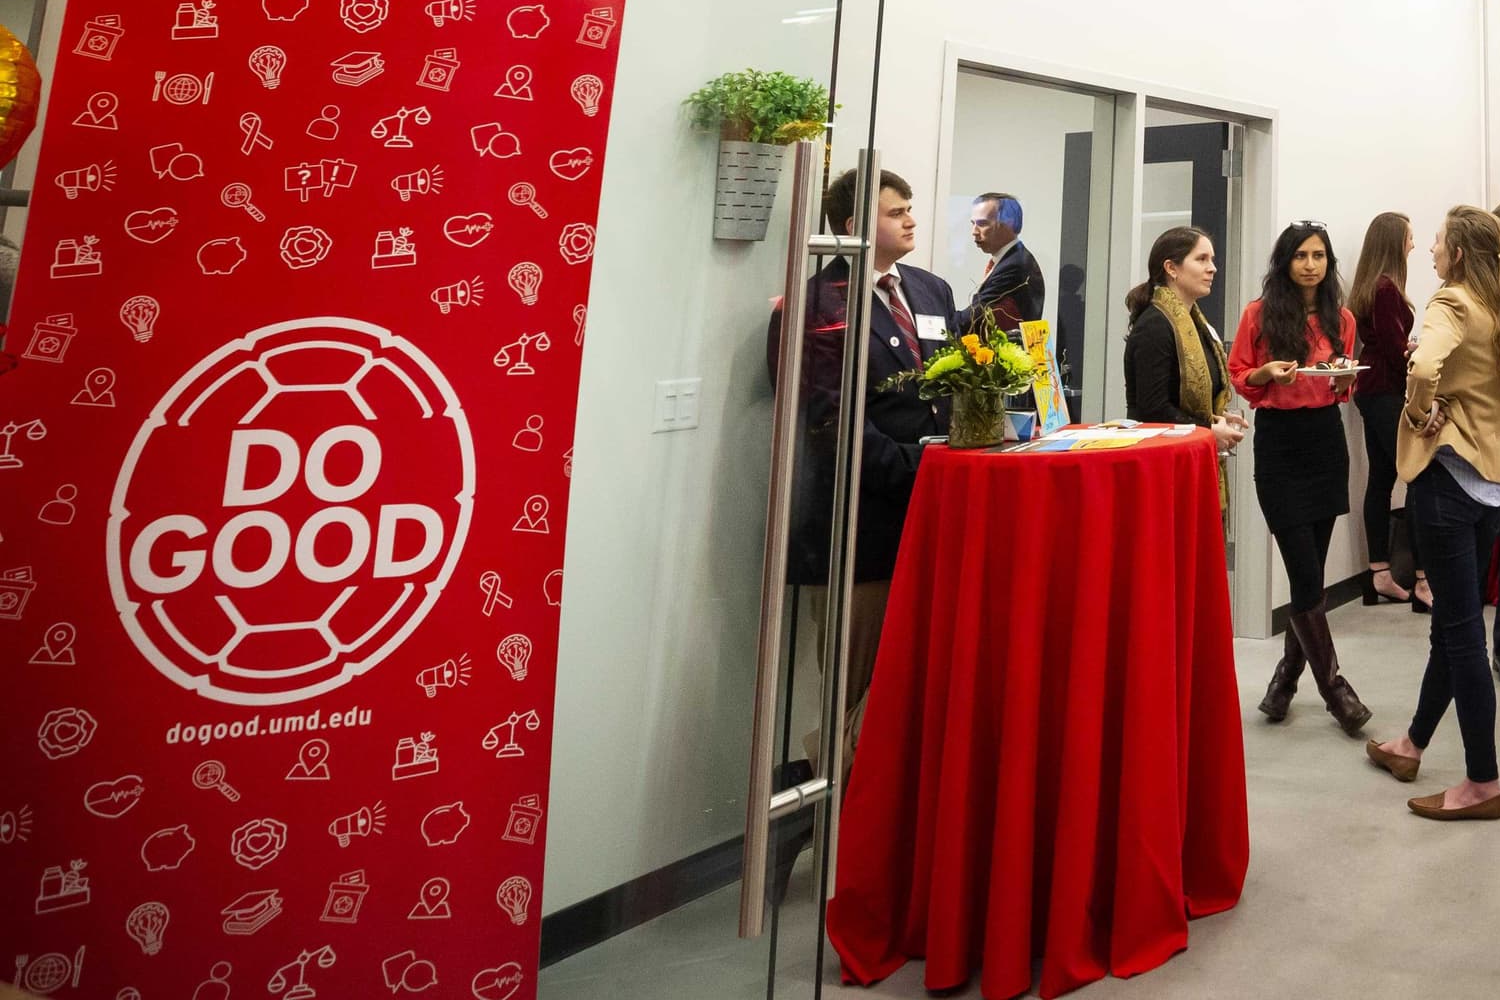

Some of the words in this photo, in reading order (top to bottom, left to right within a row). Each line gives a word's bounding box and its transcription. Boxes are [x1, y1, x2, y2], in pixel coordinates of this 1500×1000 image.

[222, 424, 382, 507] DO
[129, 503, 445, 594] GOOD
[166, 706, 373, 746] dogood.umd.edu
